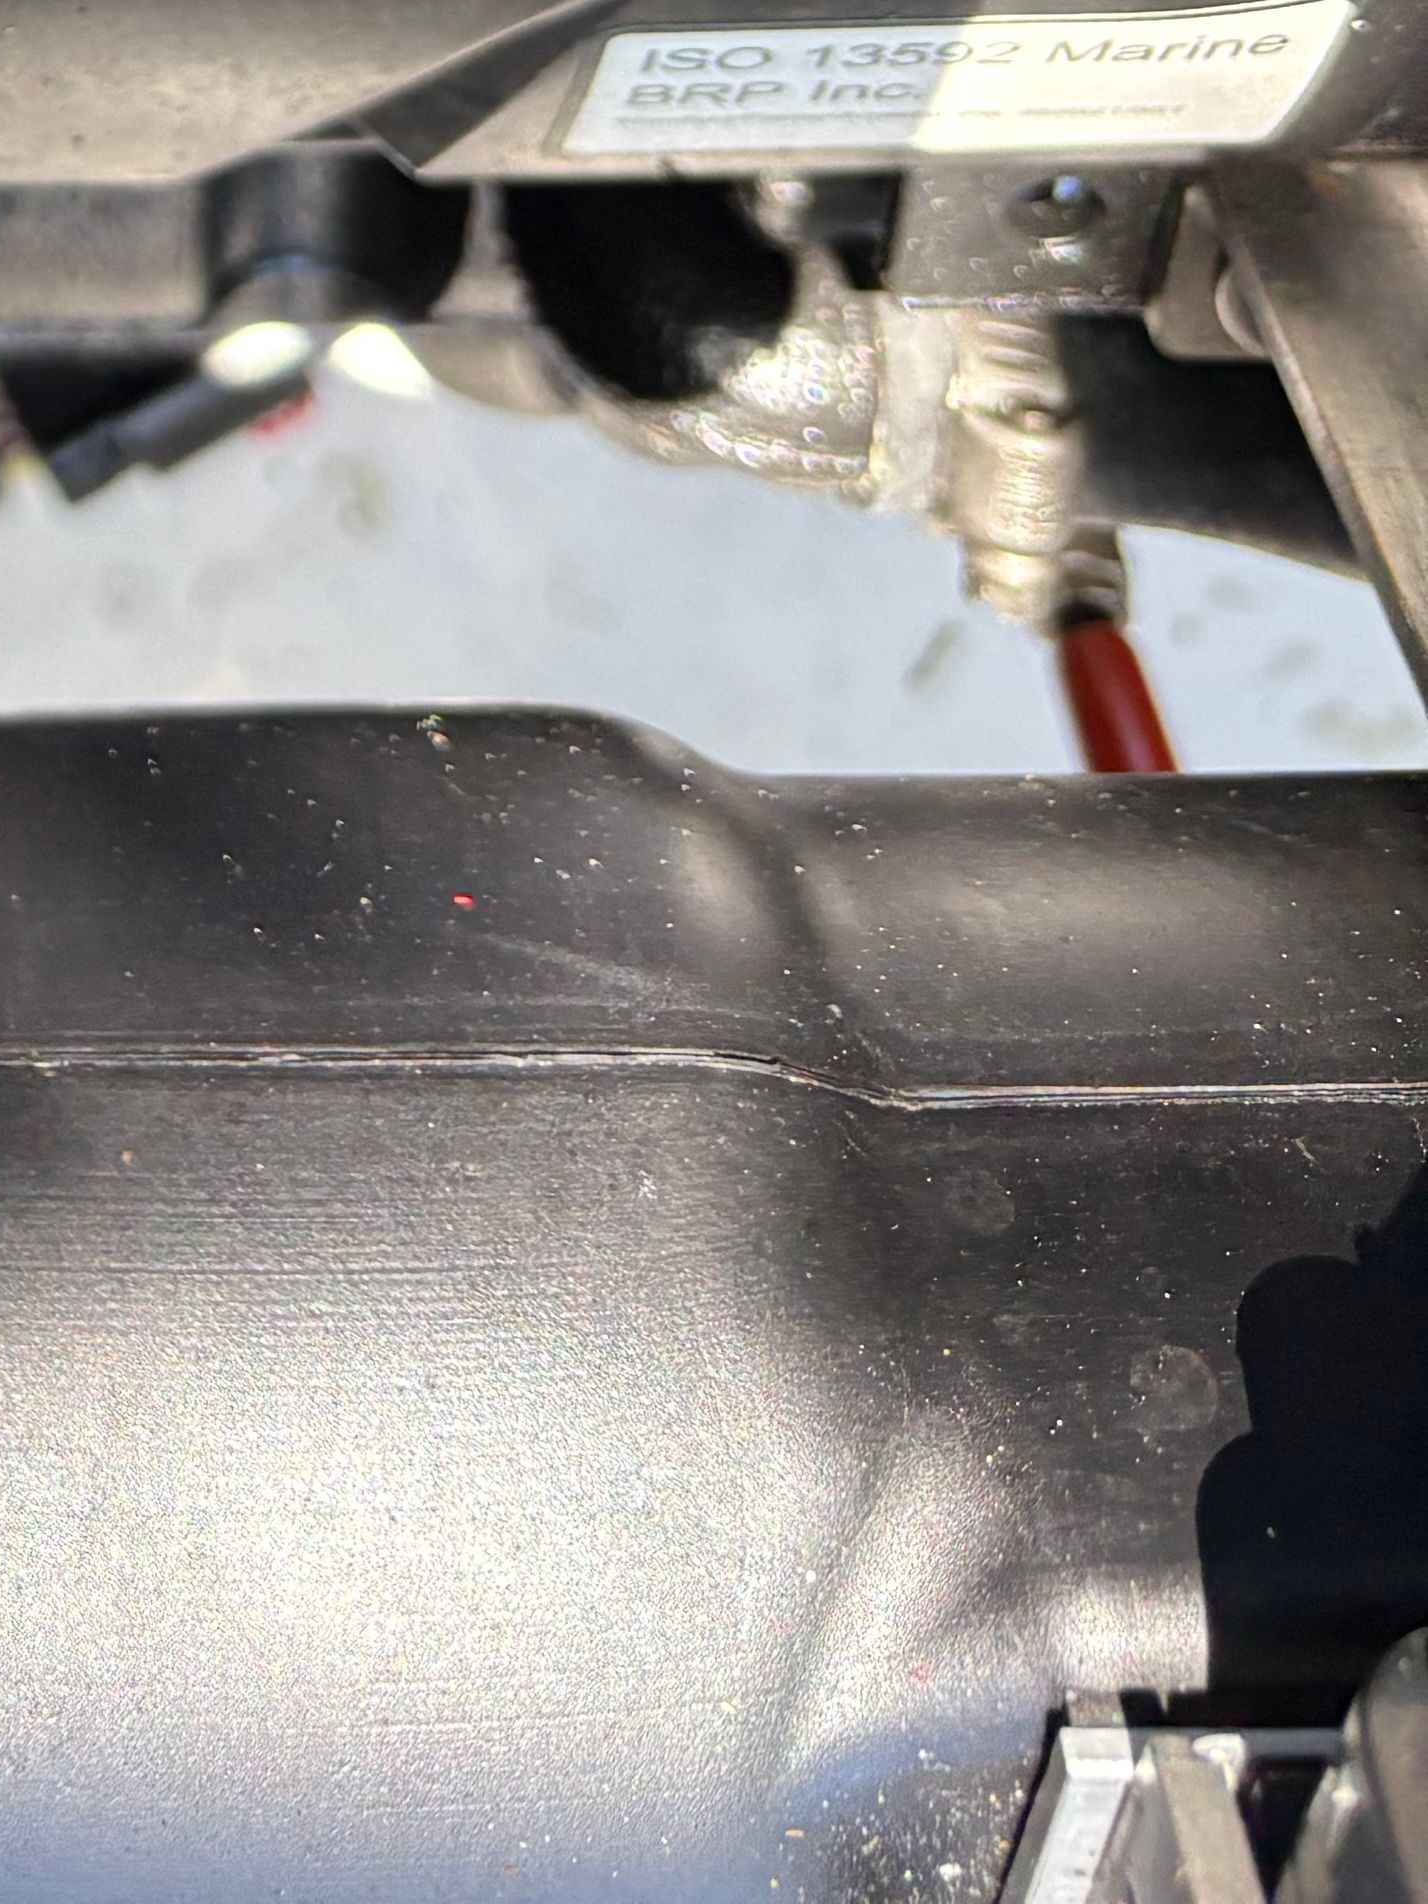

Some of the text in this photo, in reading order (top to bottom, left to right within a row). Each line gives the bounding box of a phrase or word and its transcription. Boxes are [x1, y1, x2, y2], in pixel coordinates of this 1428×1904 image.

[638, 30, 1291, 76] ISO 13592 Marine
[627, 78, 925, 108] BRP Inc.
